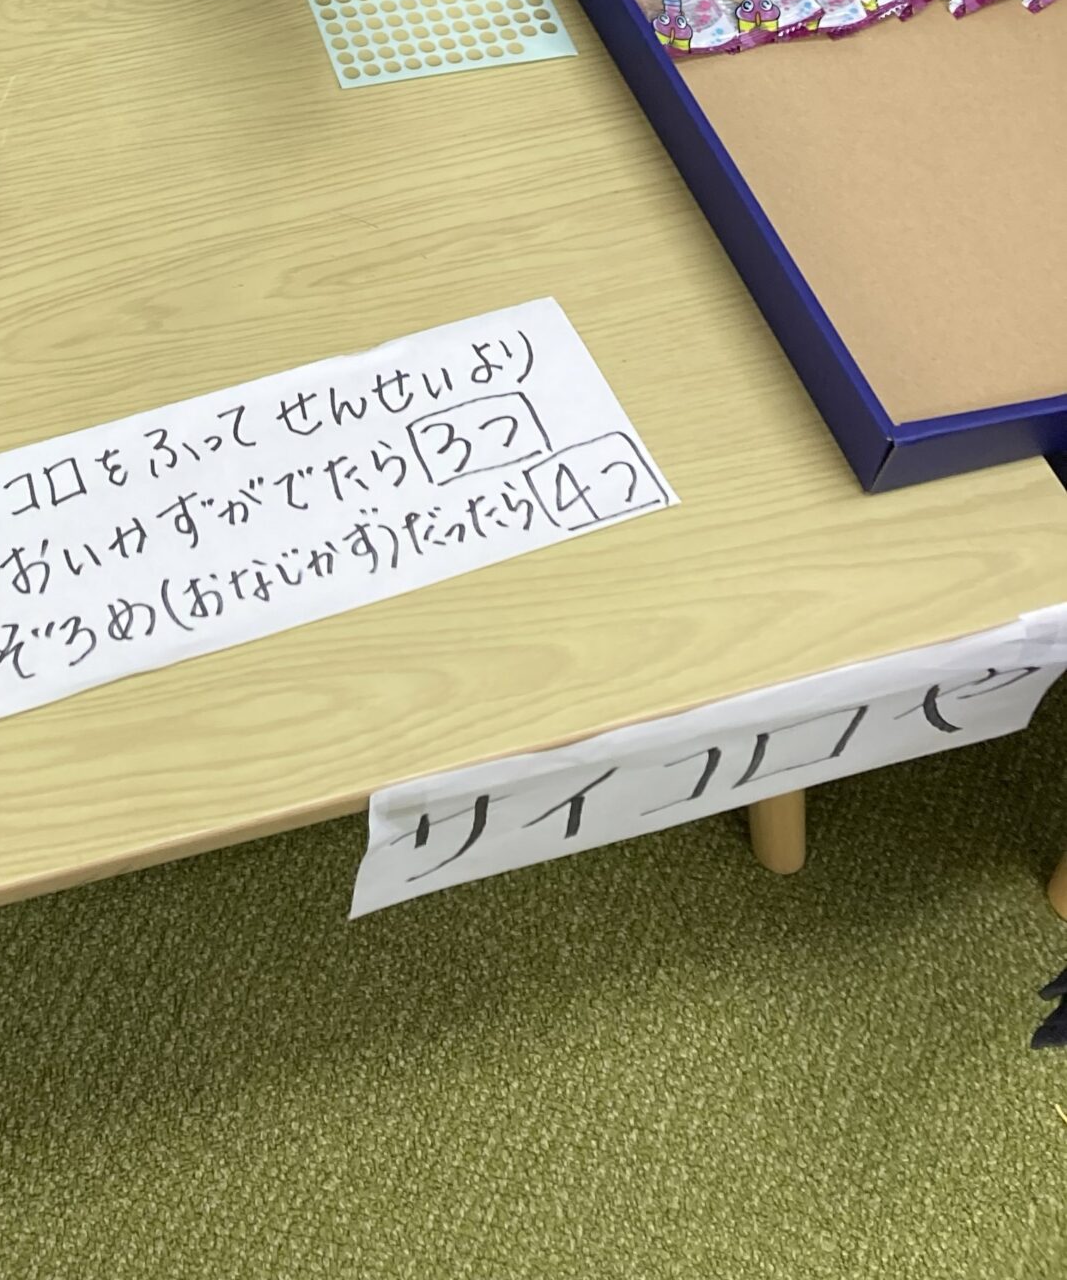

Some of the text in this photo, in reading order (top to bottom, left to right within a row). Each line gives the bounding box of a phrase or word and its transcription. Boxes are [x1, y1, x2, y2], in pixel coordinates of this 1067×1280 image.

[389, 666, 1042, 882] サイコロや
